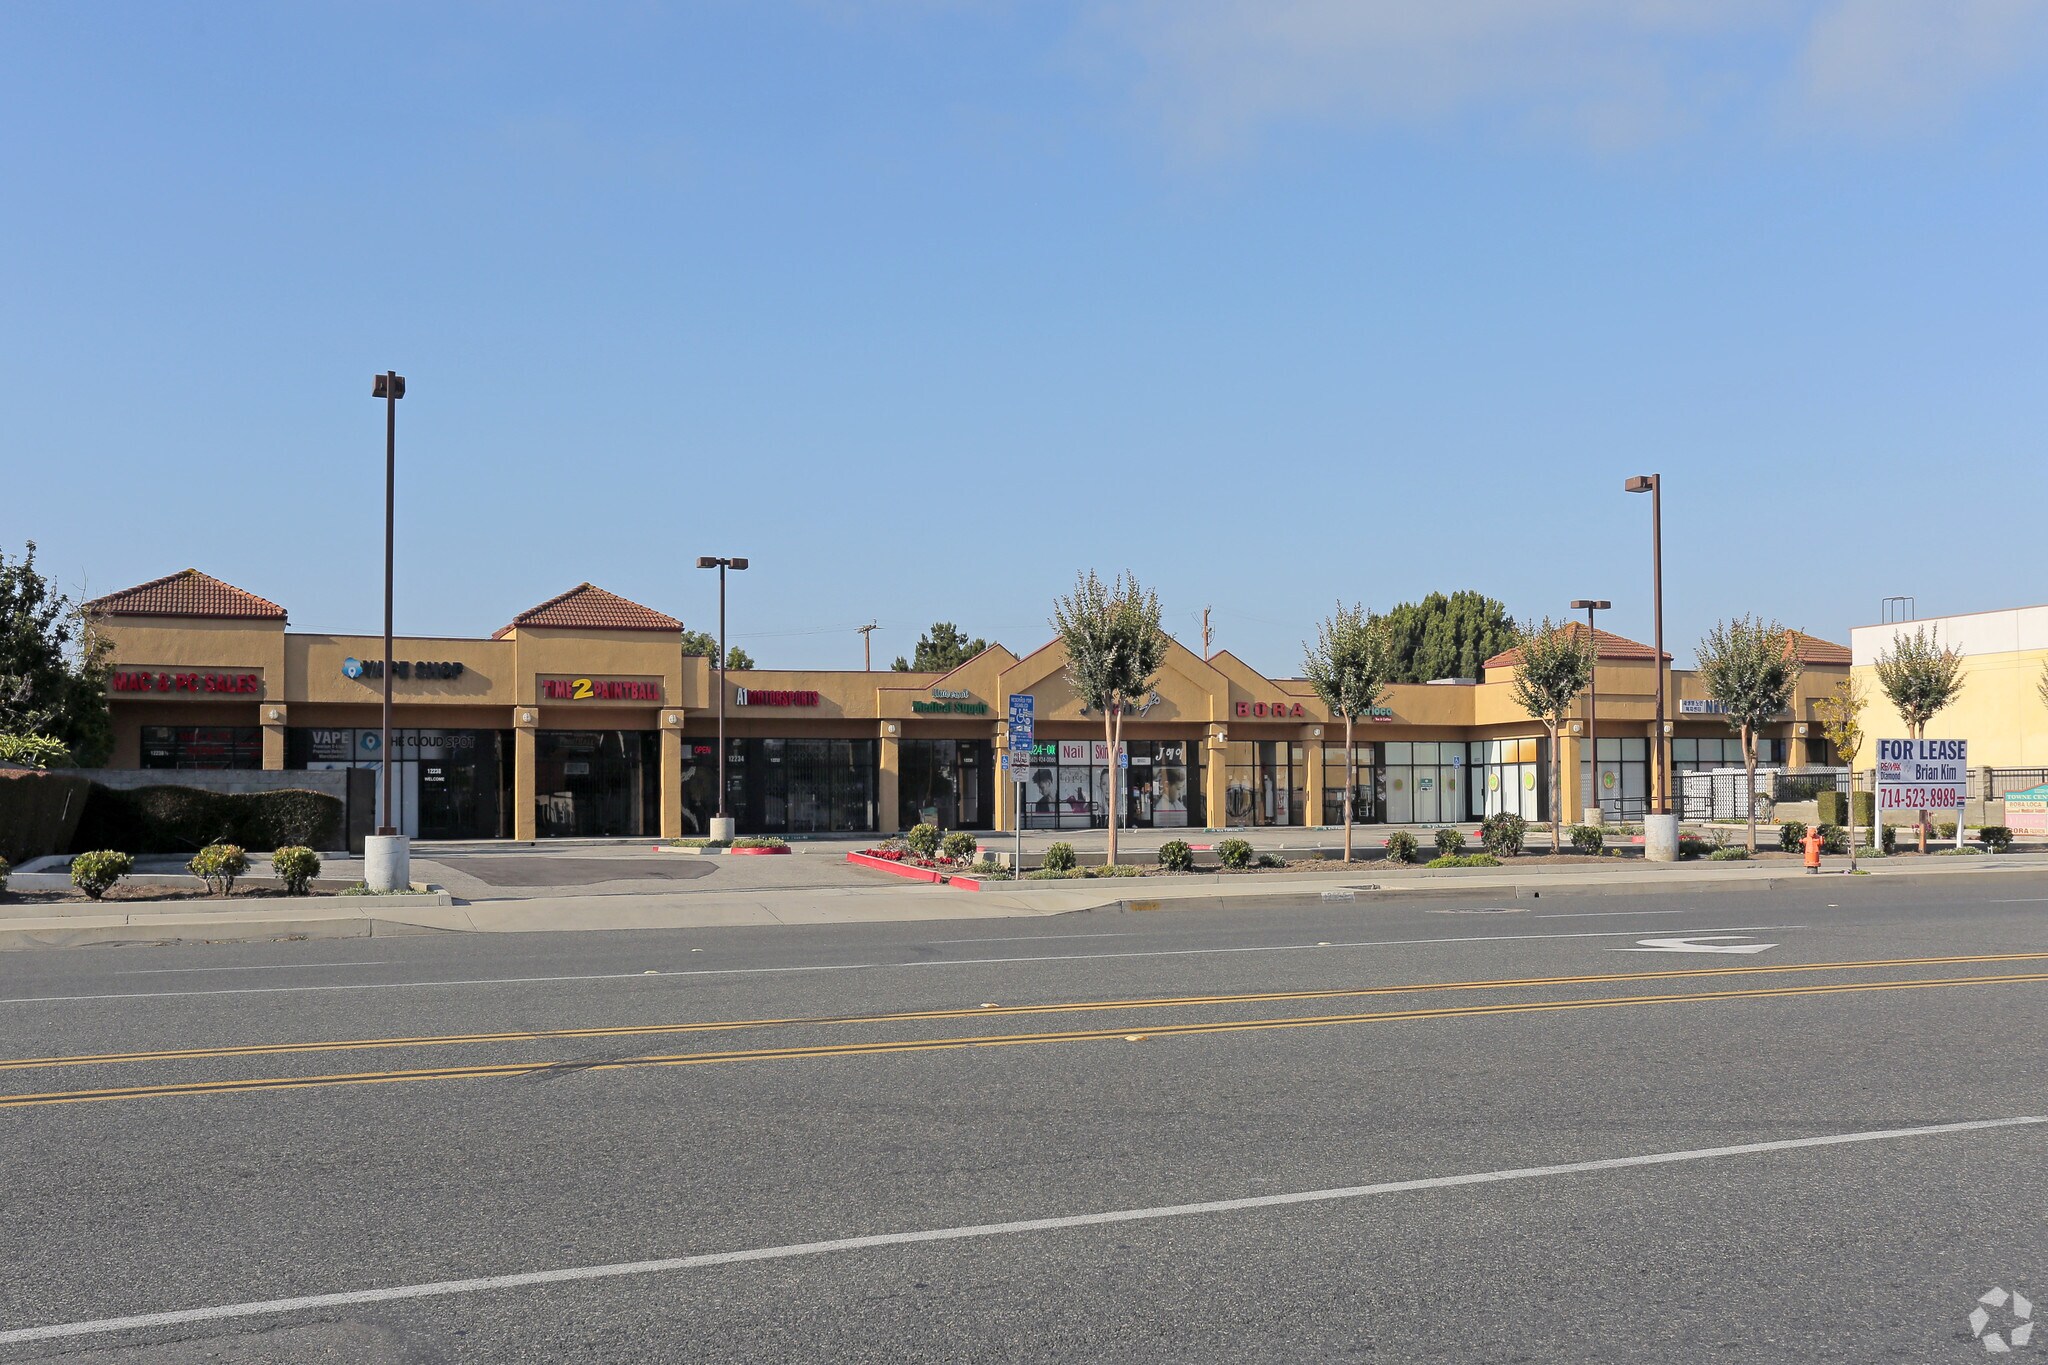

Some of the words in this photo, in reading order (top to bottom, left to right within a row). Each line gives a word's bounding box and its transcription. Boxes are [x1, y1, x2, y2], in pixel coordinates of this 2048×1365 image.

[415, 661, 464, 680] SHOP
[113, 672, 152, 692] MAC
[158, 672, 171, 692] &
[175, 672, 199, 692] PC
[204, 673, 257, 693] SALES
[543, 680, 572, 699] TIME
[572, 678, 594, 700] 2
[593, 680, 659, 700] PAINTBALL
[747, 690, 819, 707] MOTORSPORTS
[912, 701, 952, 713] Medical
[954, 702, 988, 715] Supply
[1236, 702, 1305, 718] BORA
[312, 731, 349, 744] VAPE
[407, 736, 443, 748] CLOUD
[446, 736, 475, 748] SPOT
[694, 745, 712, 754] OPEN
[1063, 745, 1084, 759] Nail
[1880, 740, 1914, 760] FOR
[1919, 740, 1966, 760] LEASE
[1880, 772, 1901, 780] Diamond
[1915, 763, 1938, 780] Brian
[1941, 763, 1957, 780] Kim
[1880, 787, 1956, 808] 714-523-8989
